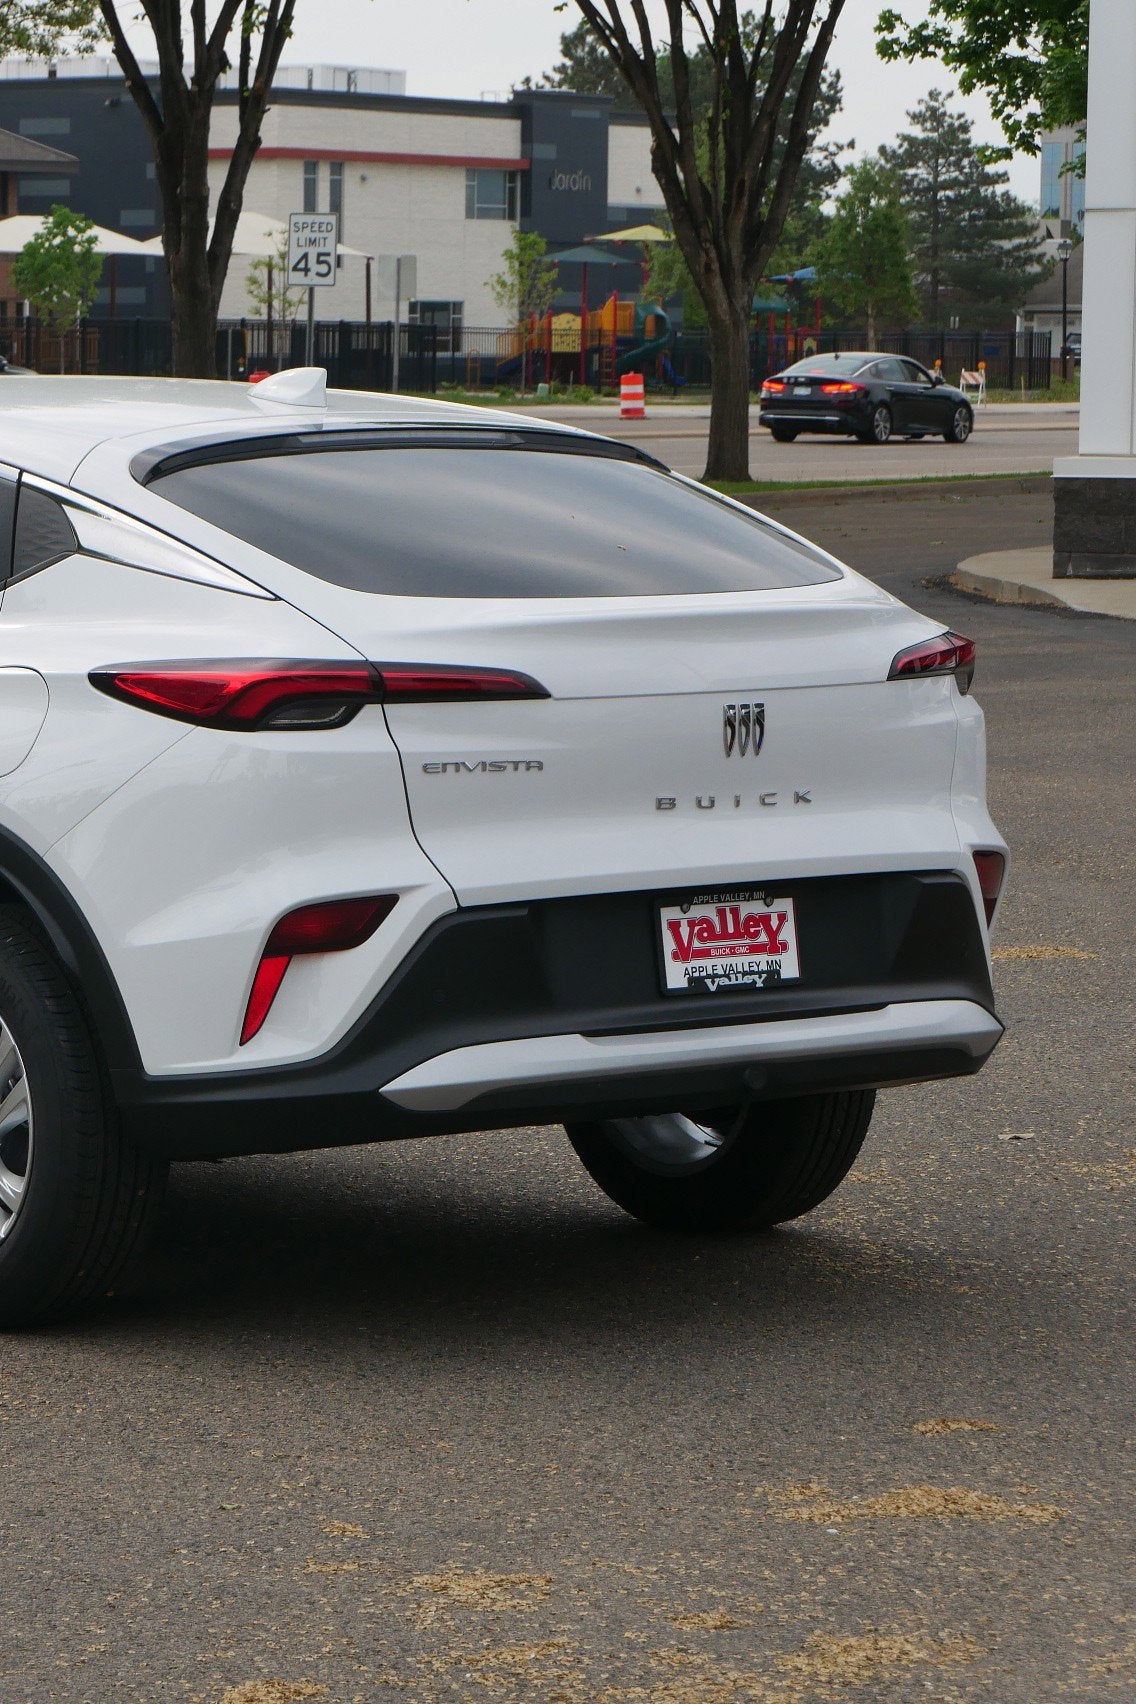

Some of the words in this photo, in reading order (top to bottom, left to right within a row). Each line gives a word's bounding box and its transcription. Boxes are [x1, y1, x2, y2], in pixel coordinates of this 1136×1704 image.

[293, 221, 334, 233] SPEED
[296, 236, 329, 248] LIMIT
[291, 251, 333, 278] 45
[421, 759, 544, 775] ENVISTA
[655, 788, 813, 811] BUICK
[692, 894, 719, 905] APPLE
[720, 892, 752, 902] VALLEY,
[753, 890, 765, 900] MN
[710, 947, 731, 956] BUICK
[735, 946, 750, 954] GMC
[683, 964, 718, 978] APPLE
[765, 959, 782, 971] MN
